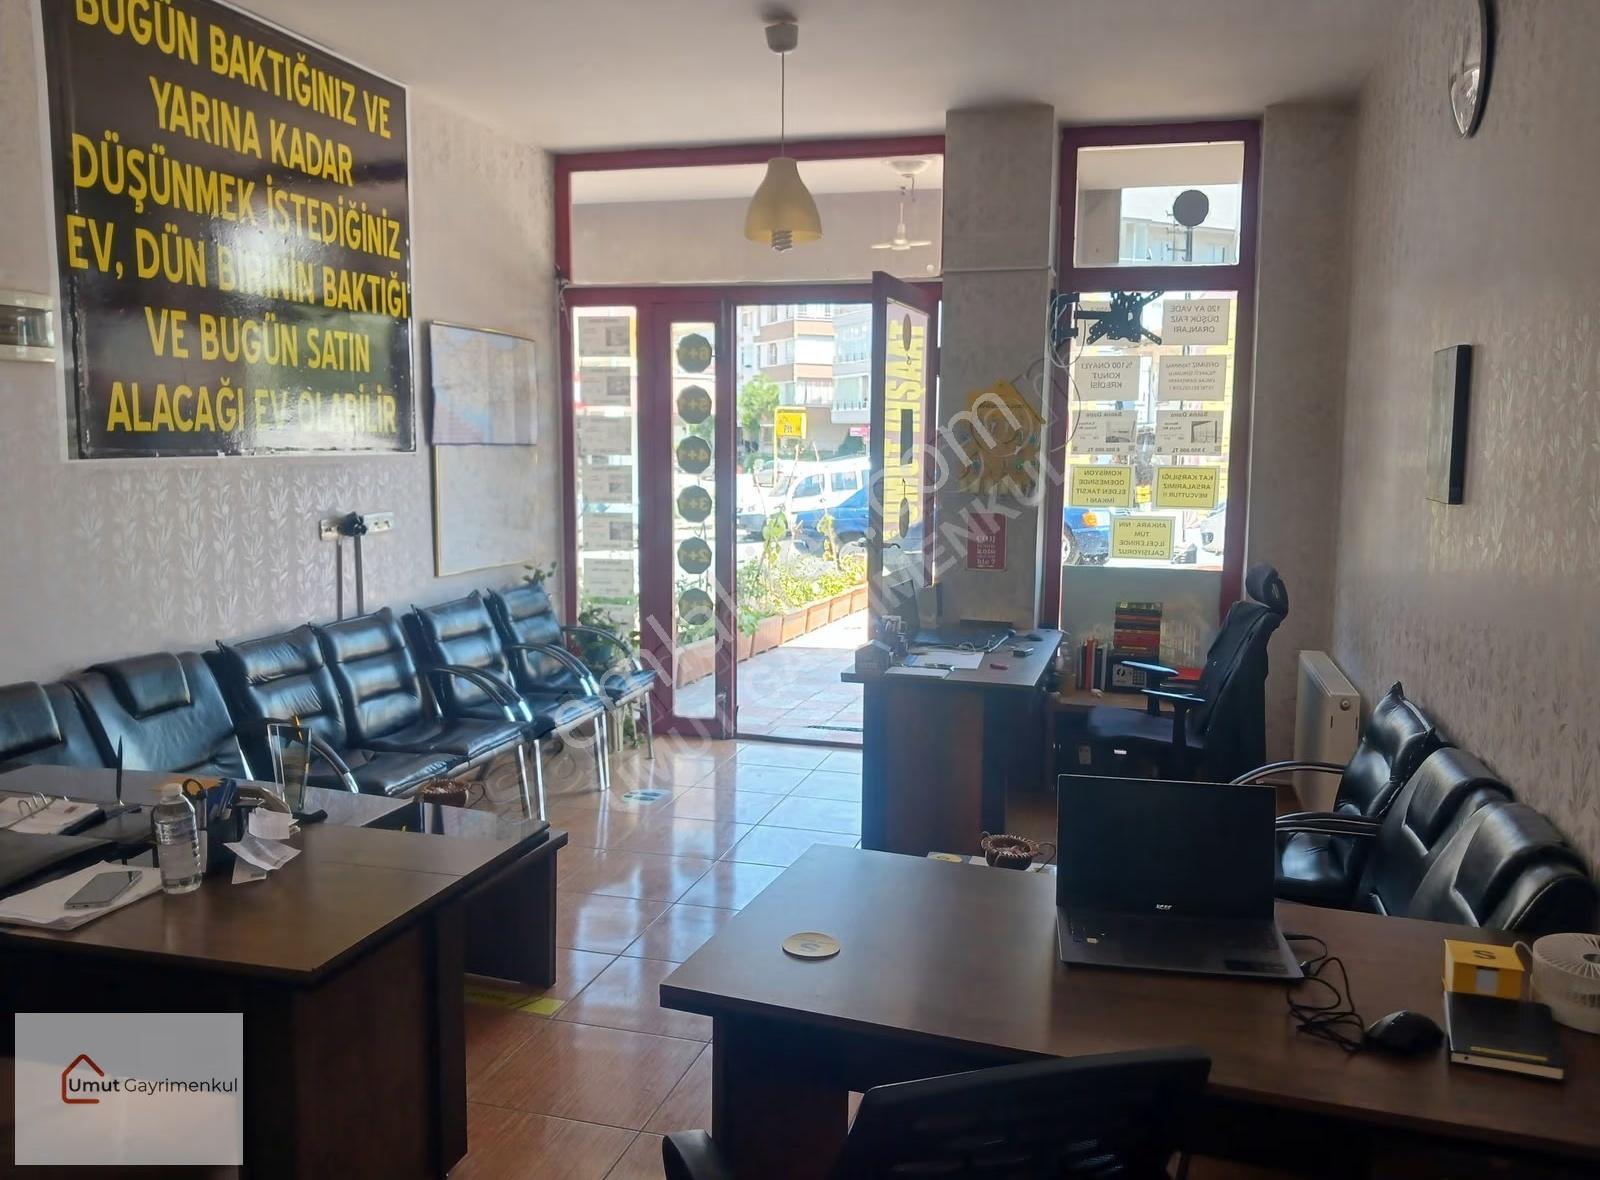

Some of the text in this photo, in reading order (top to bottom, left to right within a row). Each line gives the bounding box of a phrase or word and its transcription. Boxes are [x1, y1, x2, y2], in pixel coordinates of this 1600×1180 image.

[76, 0, 391, 138] BUGÜN BAKTIĞINIZ VE
[149, 76, 353, 187] YARINA KADAR
[72, 130, 401, 260] DÜŞÜNMEK İSTEDİĞİNİZ
[66, 214, 124, 280] EV,
[136, 223, 206, 288] DÜN
[323, 266, 408, 319] BAKTIĞI
[145, 306, 370, 372] VE BUGÜN SATIN
[107, 376, 244, 432] ALACAĞI
[256, 389, 288, 431] EV
